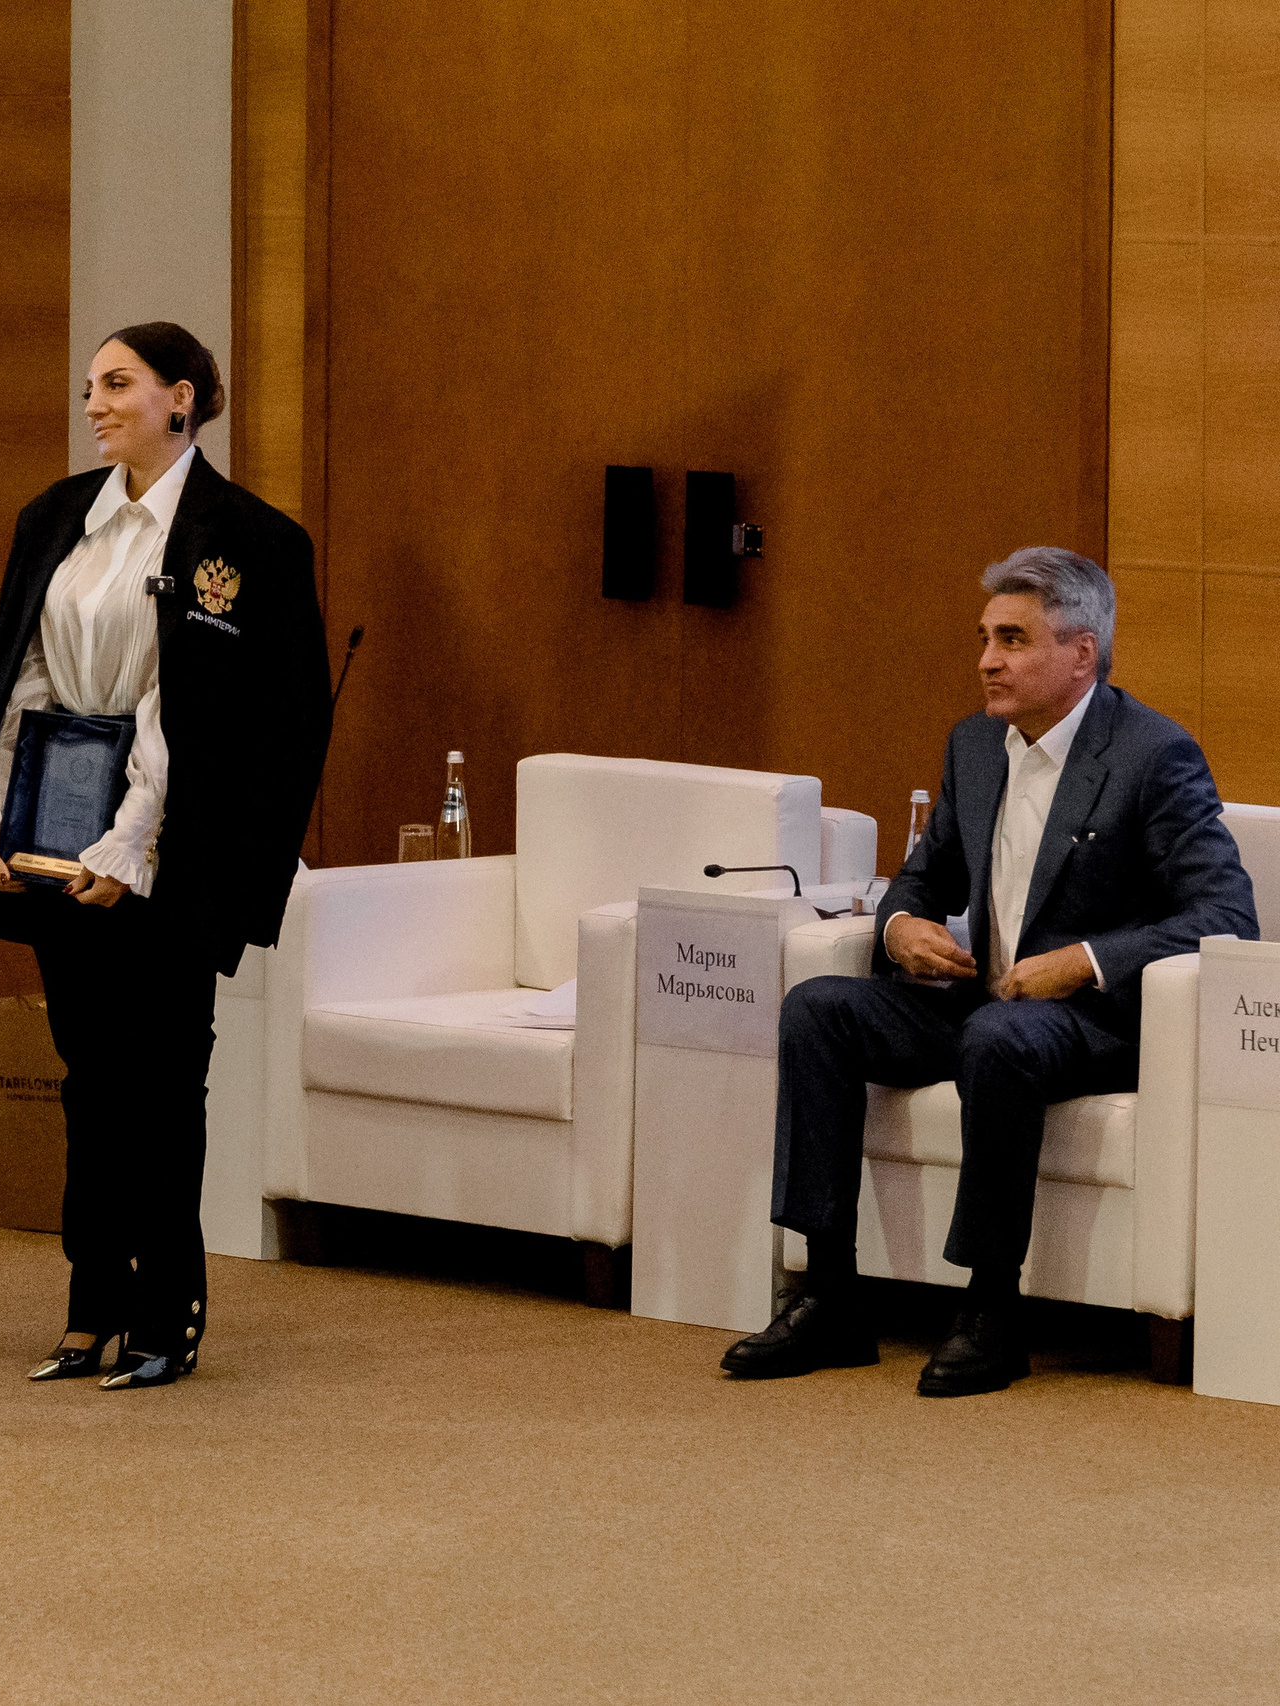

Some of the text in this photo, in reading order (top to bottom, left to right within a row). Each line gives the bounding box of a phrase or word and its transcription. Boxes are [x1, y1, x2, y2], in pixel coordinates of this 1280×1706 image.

[204, 614, 241, 637] ИМПЕРИИ
[676, 942, 737, 972] Мария
[657, 972, 756, 1004] Марьясова
[1240, 1028, 1280, 1053] Неч
